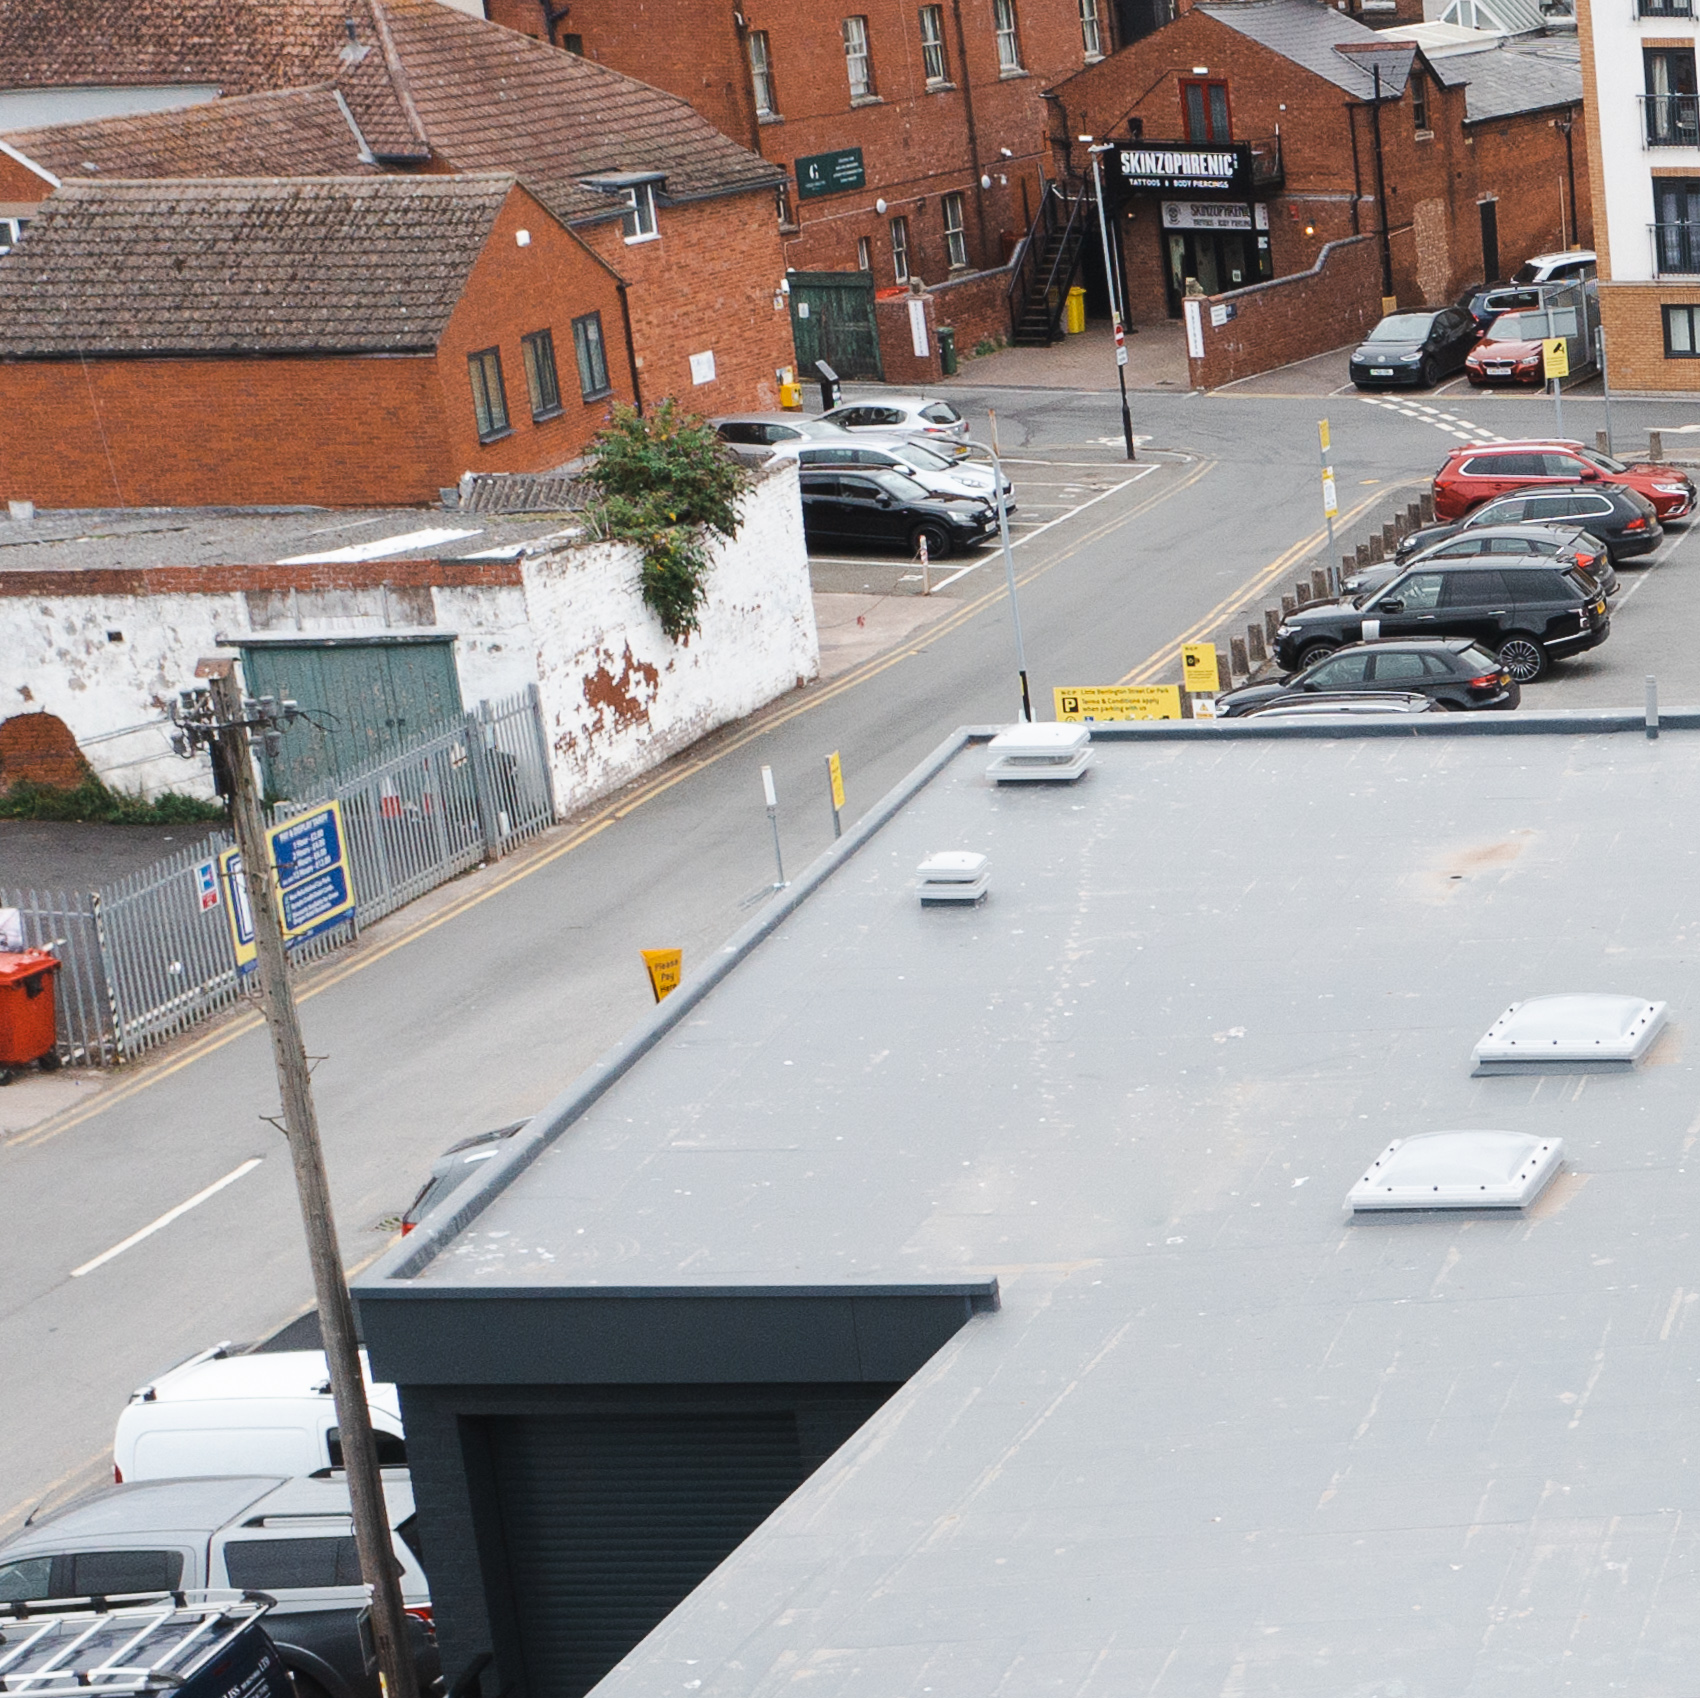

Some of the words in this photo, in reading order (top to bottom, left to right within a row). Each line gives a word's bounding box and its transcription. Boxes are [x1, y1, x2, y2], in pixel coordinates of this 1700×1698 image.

[1120, 152, 1233, 176] SKINZOPHRENIC
[1129, 178, 1160, 187] TATTOOS
[1174, 180, 1191, 188] BODY
[1193, 180, 1229, 188] PIERCINGS
[1142, 698, 1160, 706] apply
[1100, 705, 1124, 713] parking
[1125, 704, 1138, 712] with
[655, 958, 678, 971] Please
[661, 972, 674, 982] Pay
